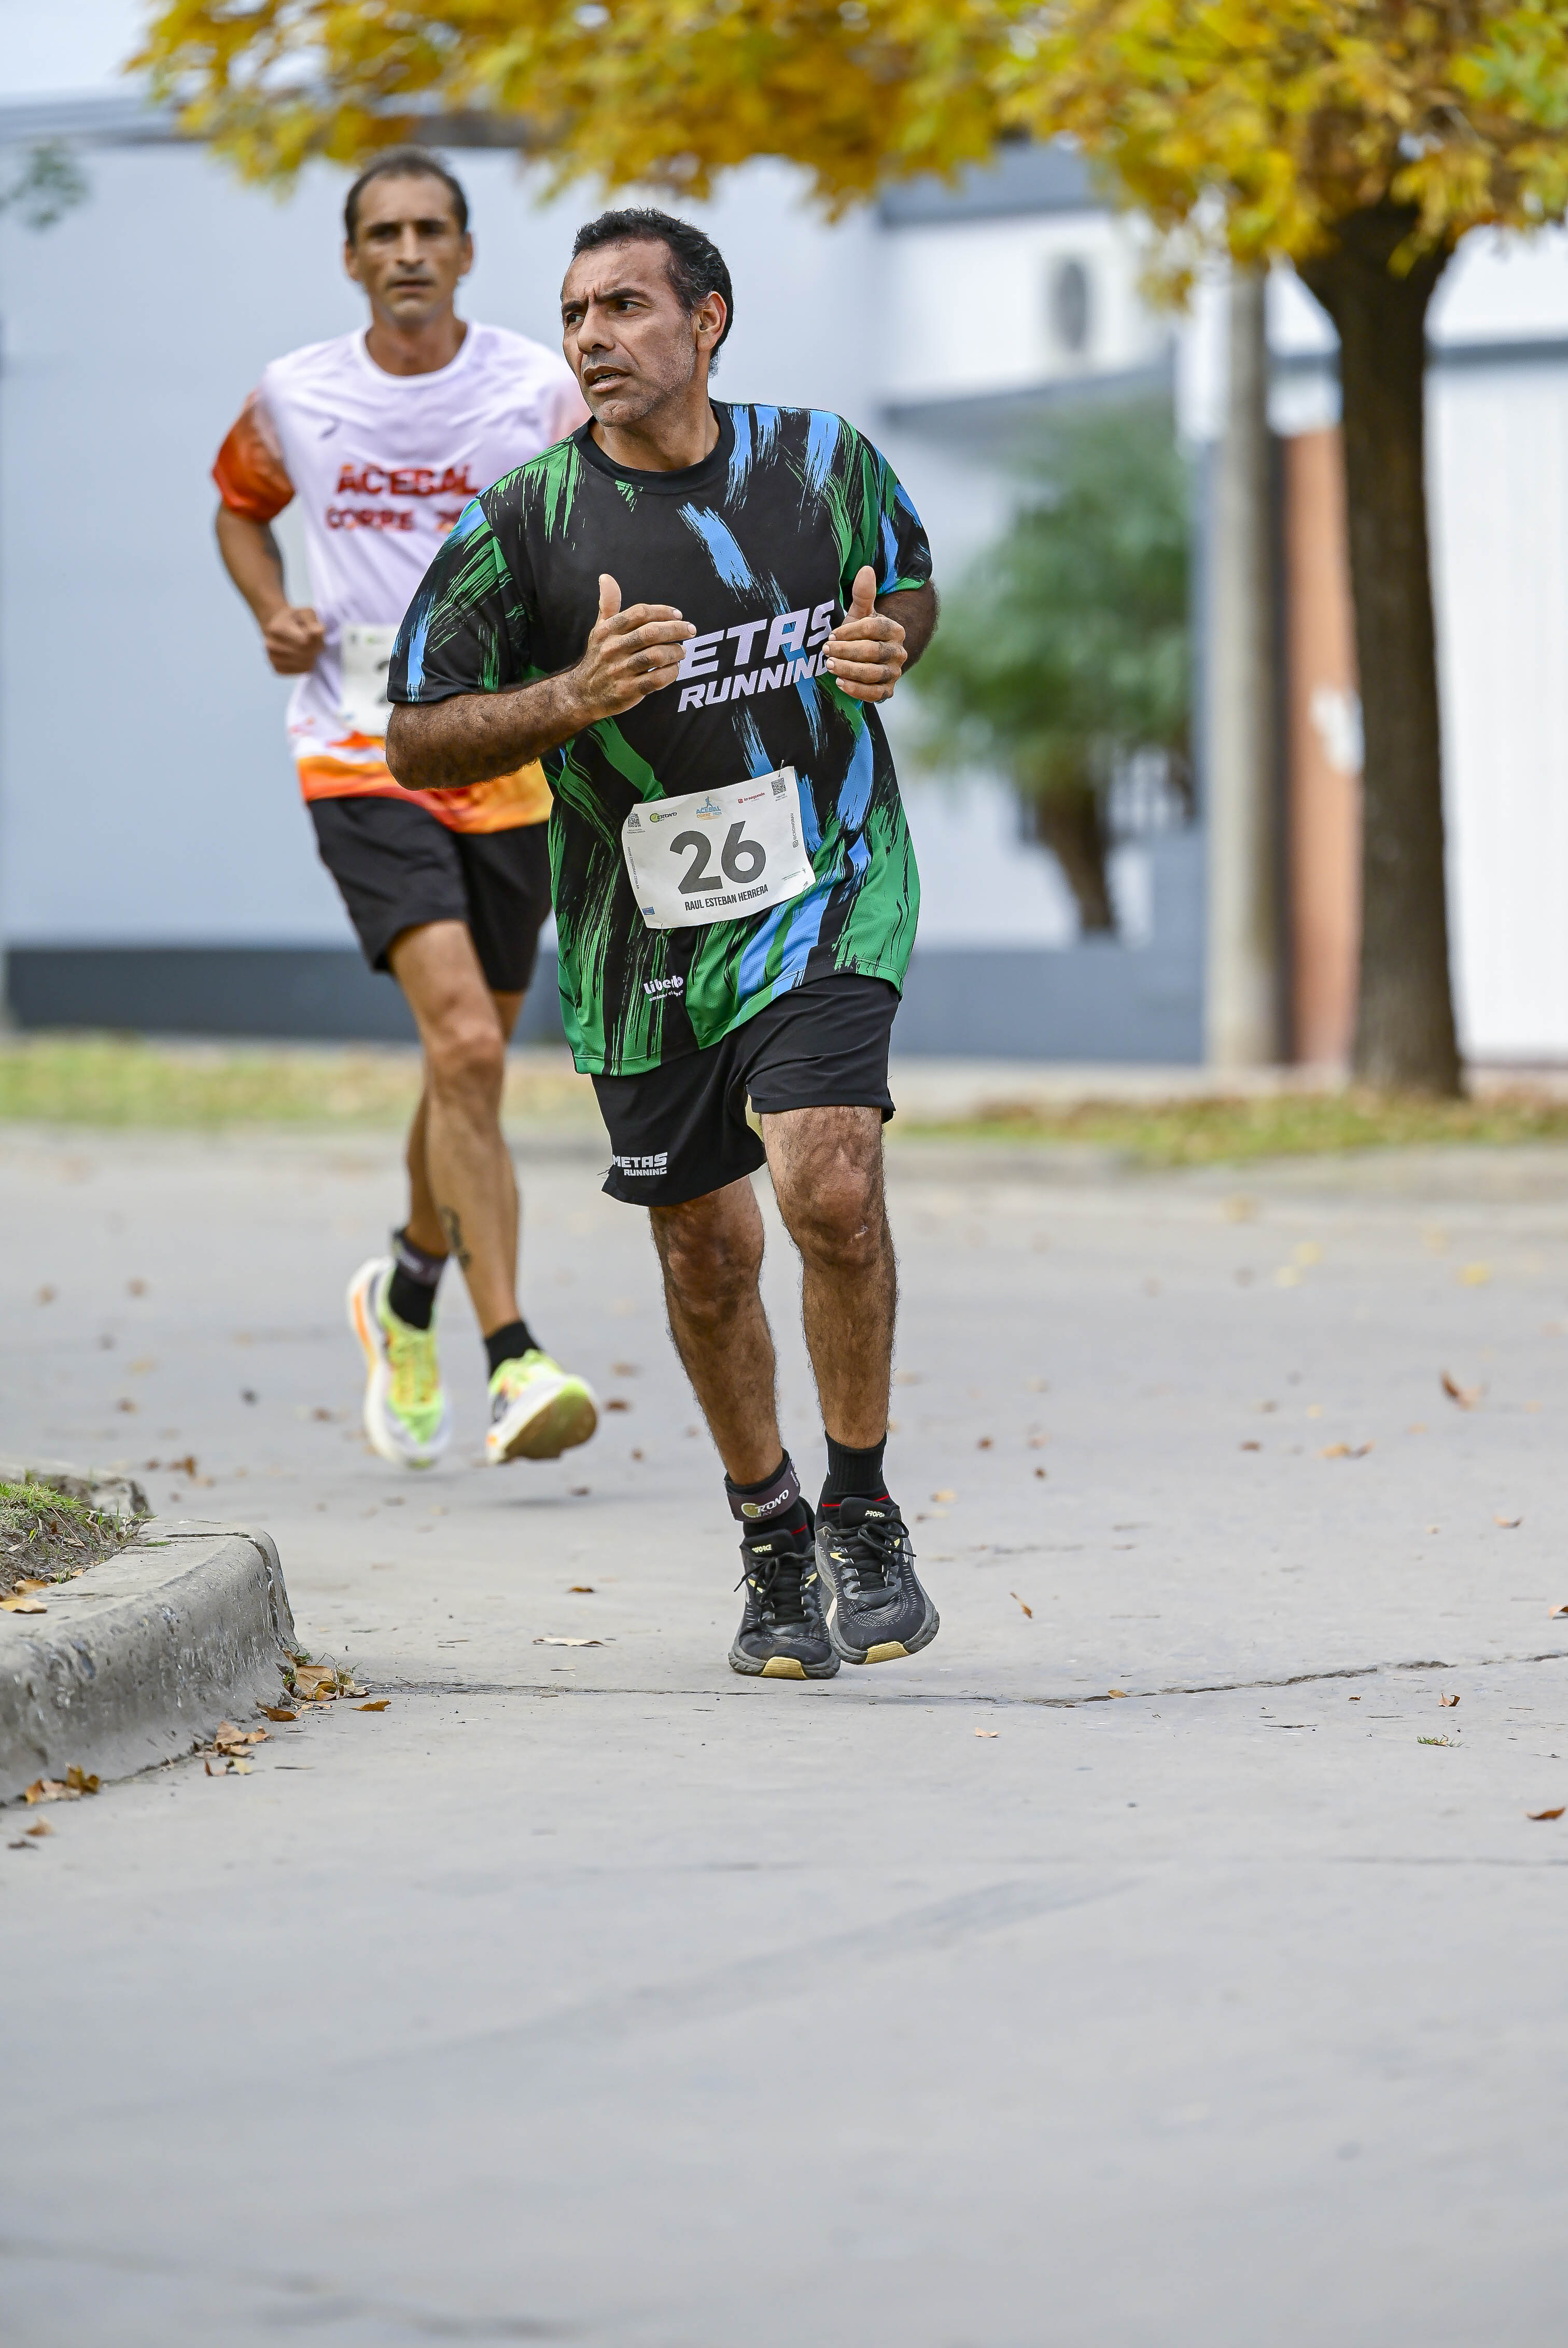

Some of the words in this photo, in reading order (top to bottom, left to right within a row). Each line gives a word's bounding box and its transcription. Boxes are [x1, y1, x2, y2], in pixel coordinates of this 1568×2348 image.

[676, 599, 835, 681] ETAS
[669, 820, 766, 895] 26
[684, 900, 705, 911] RAUL
[705, 894, 737, 907] ESTEBAN
[738, 884, 768, 902] HERRERA
[612, 1152, 668, 1168] METAS
[624, 1167, 667, 1176] RUNNING
